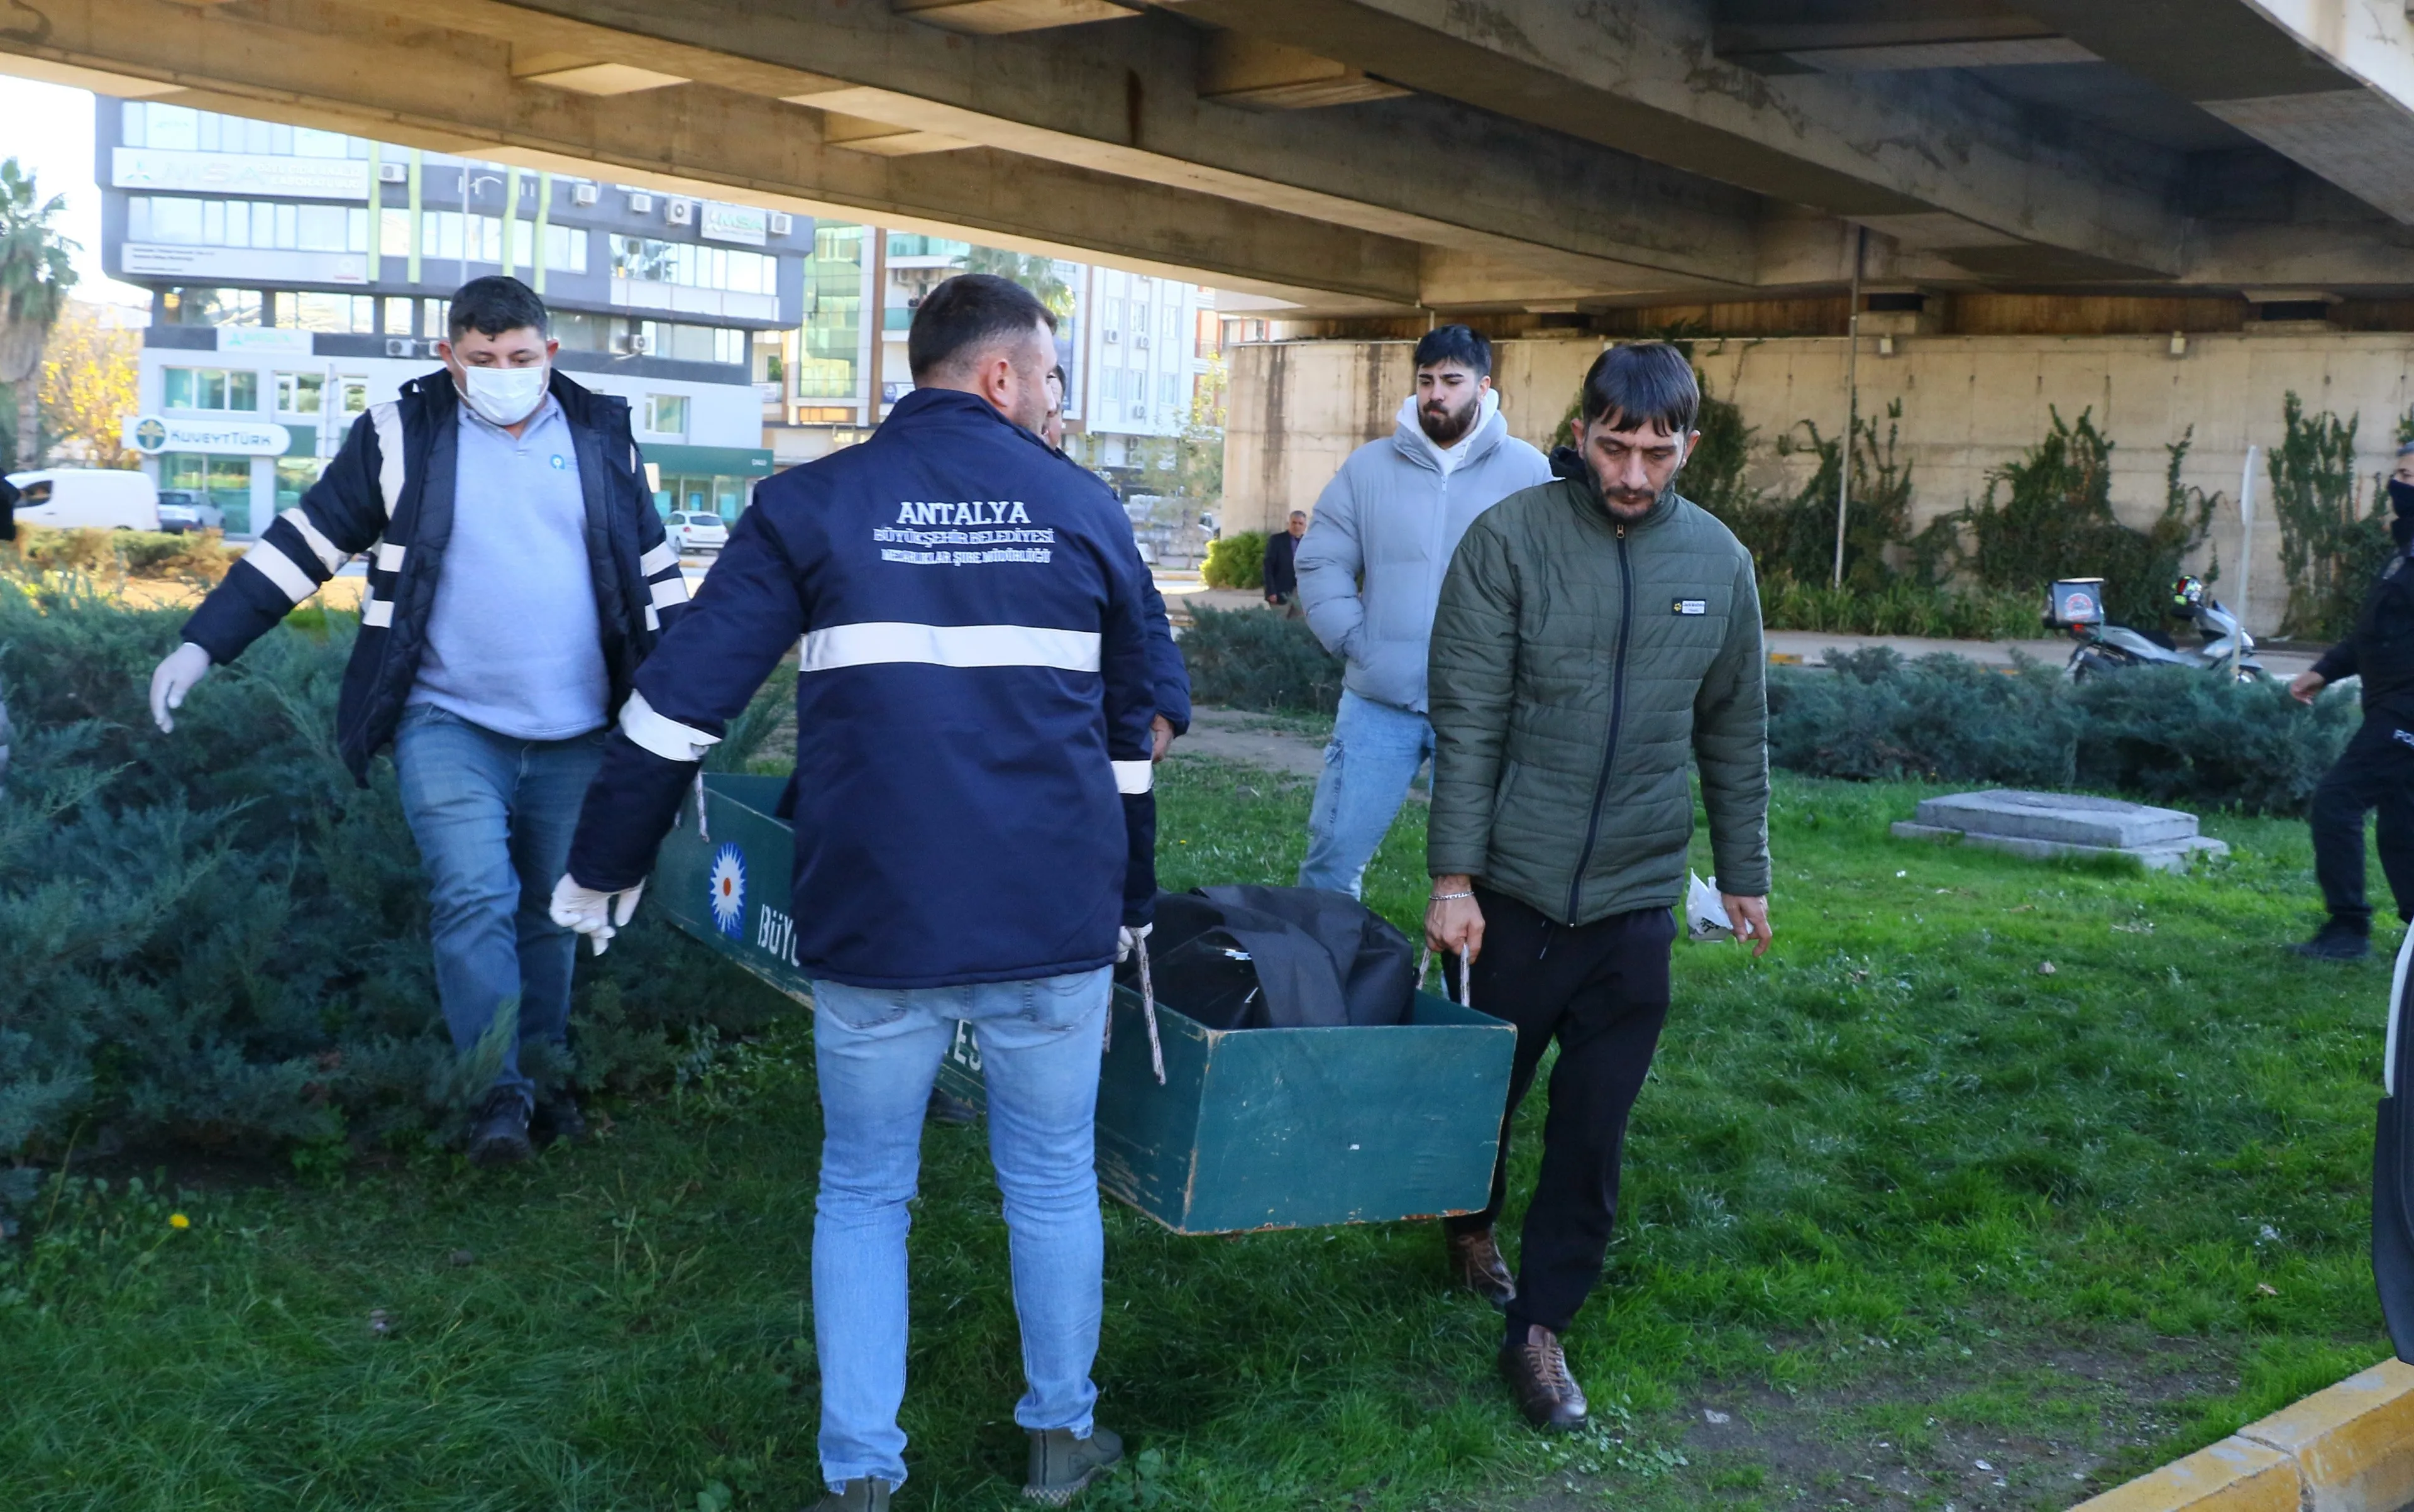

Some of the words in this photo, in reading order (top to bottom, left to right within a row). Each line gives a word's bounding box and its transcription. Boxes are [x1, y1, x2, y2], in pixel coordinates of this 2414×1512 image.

[896, 501, 1032, 525] ANTALYA
[873, 526, 969, 548] BÜYÜKŞEHİR
[968, 527, 1055, 544] BELEDİYESİ
